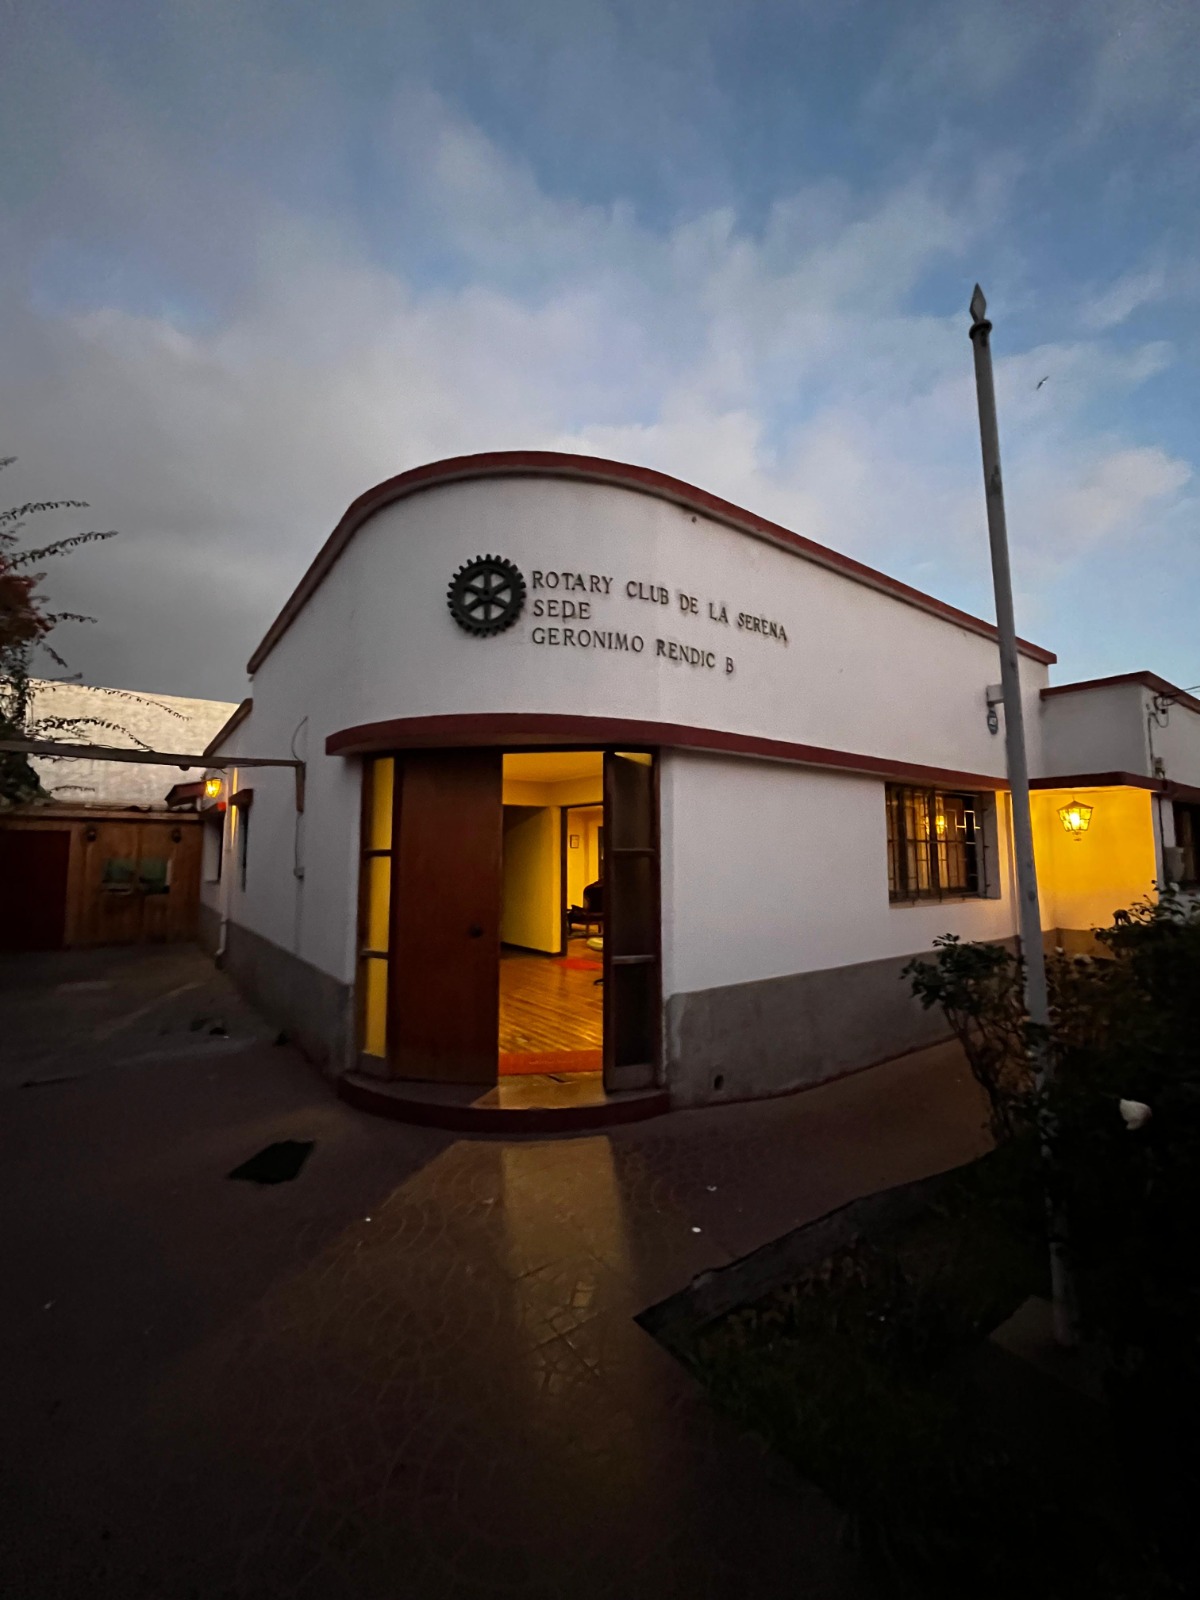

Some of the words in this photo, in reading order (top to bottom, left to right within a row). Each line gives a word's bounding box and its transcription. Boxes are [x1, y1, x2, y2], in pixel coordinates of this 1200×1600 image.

[531, 571, 613, 594] ROTARY
[626, 580, 669, 605] CLUB
[679, 593, 699, 614] DE
[708, 603, 729, 623] LA
[737, 612, 787, 641] SERENA
[533, 599, 591, 620] SEDE
[531, 627, 644, 653] GERONIMO
[655, 639, 716, 668] RENDIC
[725, 656, 735, 674] B
